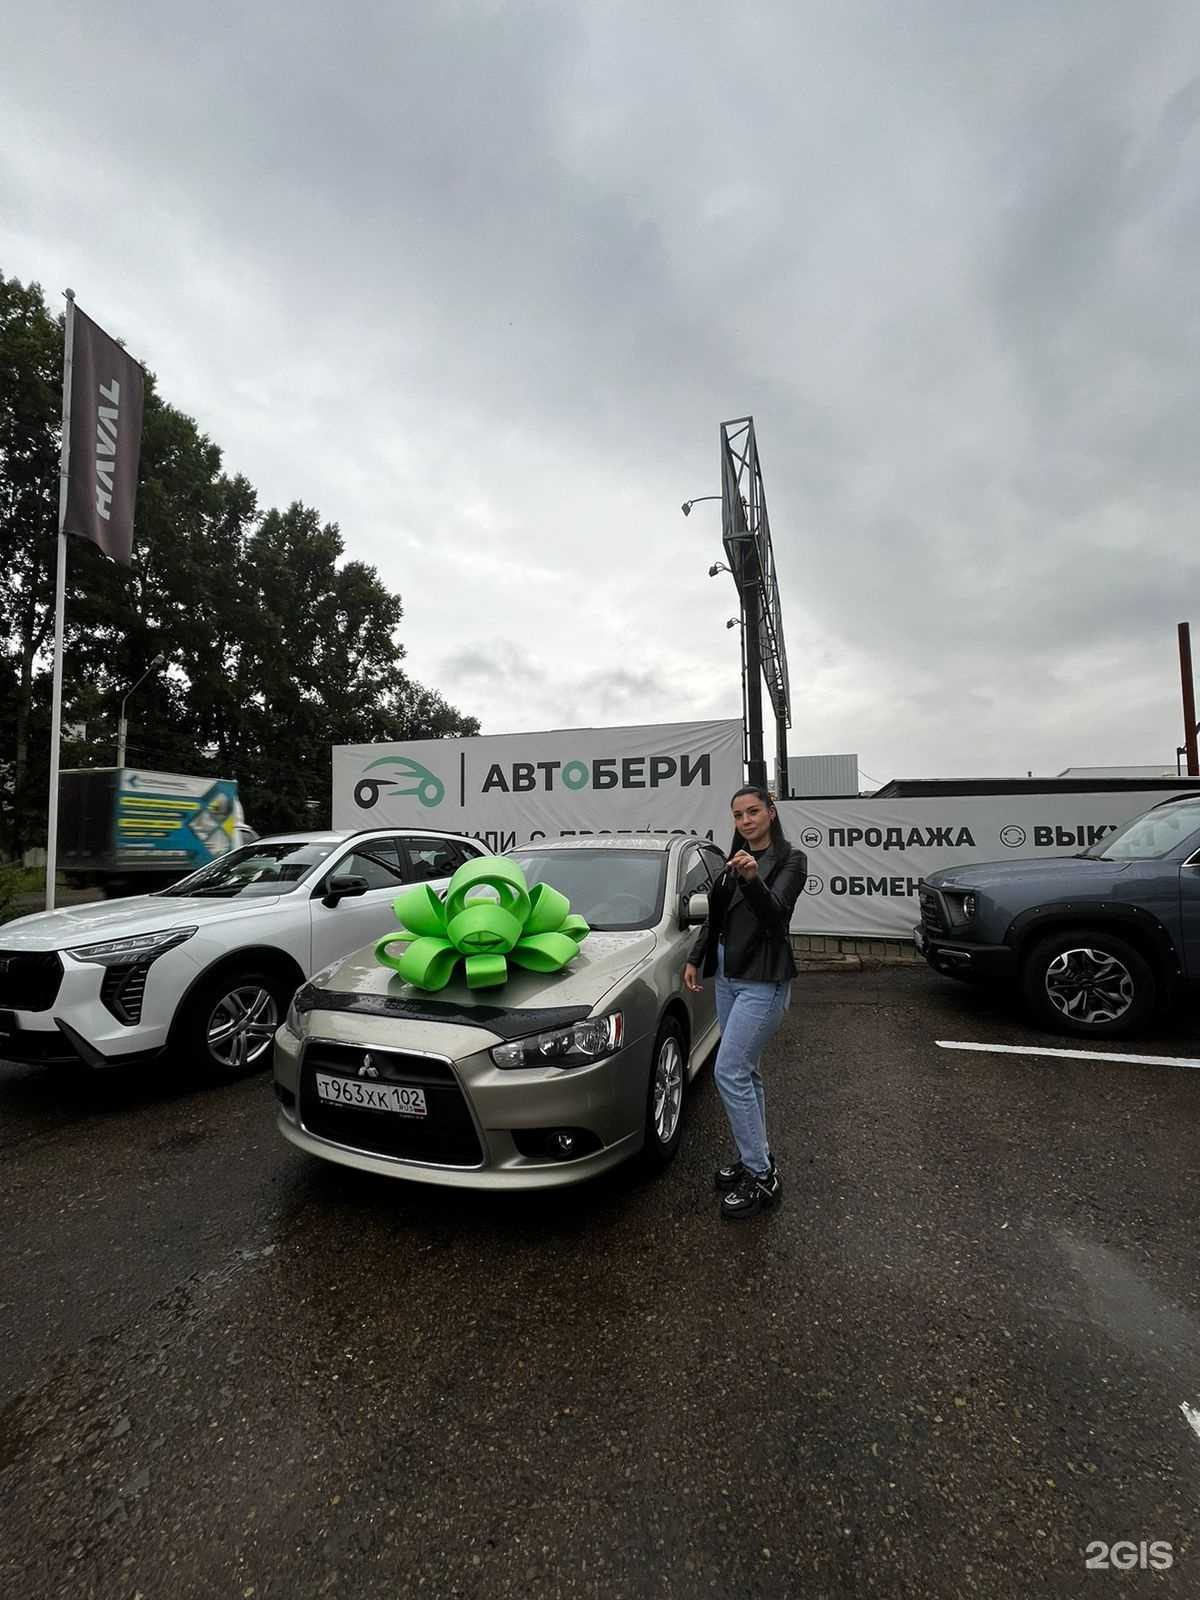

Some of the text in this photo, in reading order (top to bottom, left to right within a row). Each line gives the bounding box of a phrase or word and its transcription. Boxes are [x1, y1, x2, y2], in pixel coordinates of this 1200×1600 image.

[96, 379, 120, 521] HAVAL
[481, 753, 711, 793] АВТОБЕРИ
[828, 827, 976, 850] ПРОДАЖА
[1034, 825, 1117, 847] ВЫК
[830, 876, 924, 897] ОБМЕН
[391, 1088, 421, 1107] 102
